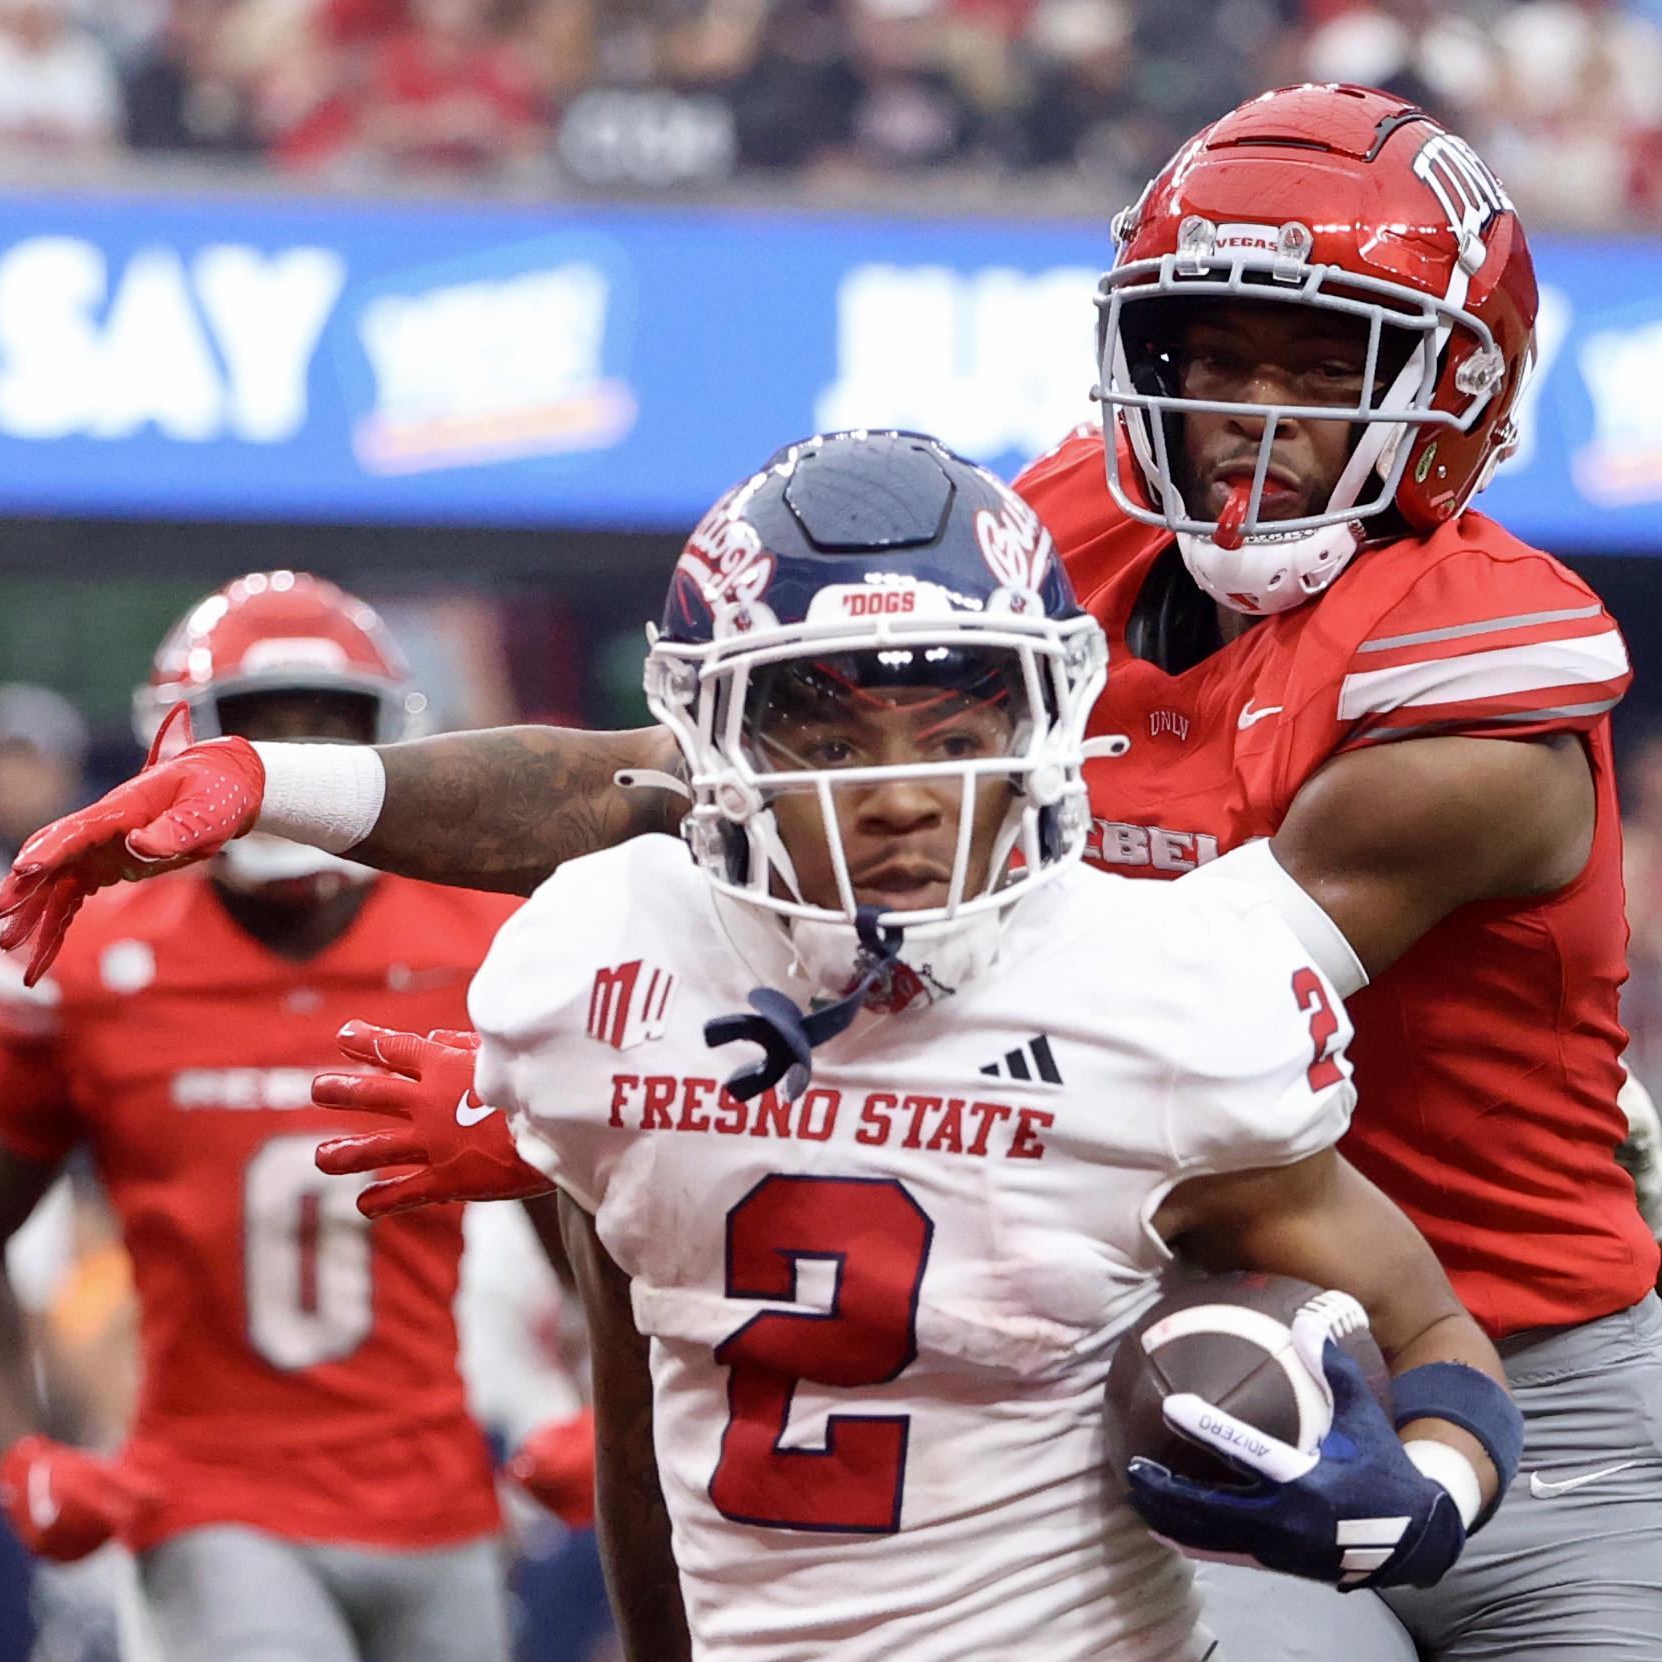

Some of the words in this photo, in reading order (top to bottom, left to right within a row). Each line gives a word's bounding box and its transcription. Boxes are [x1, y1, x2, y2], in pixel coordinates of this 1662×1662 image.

[1216, 236, 1280, 252] VEGAS
[1148, 710, 1190, 741] UNLV
[1291, 966, 1346, 1094] 2
[608, 1074, 842, 1142] FRESNO
[855, 1092, 1055, 1160] STATE
[244, 1130, 377, 1374] 0
[707, 1172, 935, 1534] 2
